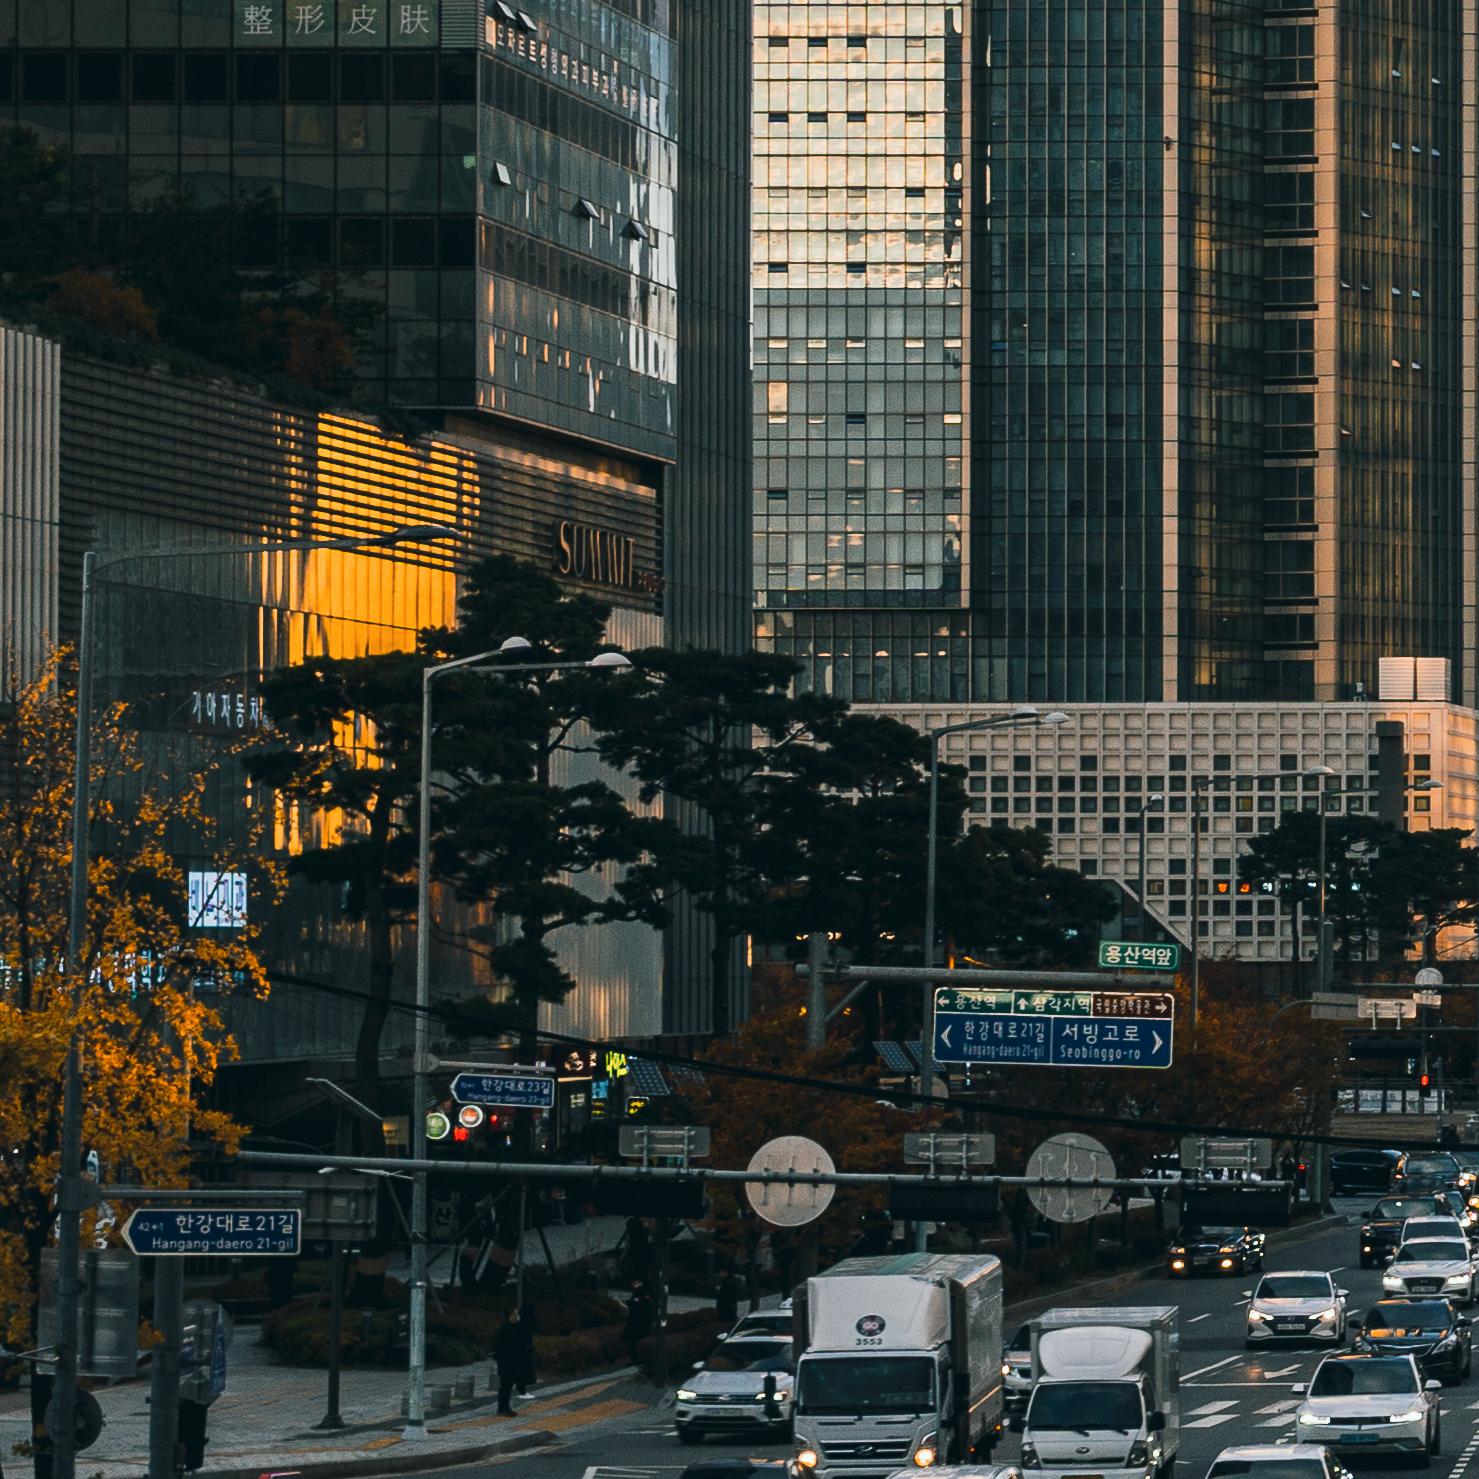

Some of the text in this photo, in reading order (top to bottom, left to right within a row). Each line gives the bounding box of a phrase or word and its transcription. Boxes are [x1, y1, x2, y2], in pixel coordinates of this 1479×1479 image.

[243, 4, 429, 35] 整形皮肤
[192, 691, 260, 728] 기아자동차
[1105, 945, 1172, 966] 용산역앞
[1031, 996, 1090, 1012] 삼각지역
[1061, 1023, 1140, 1045] 서빙고로
[1060, 1044, 1141, 1061] Seobinggo-ro
[175, 1213, 294, 1235] 한강대로21길
[152, 1237, 294, 1251] Hangang-daero 21-gil
